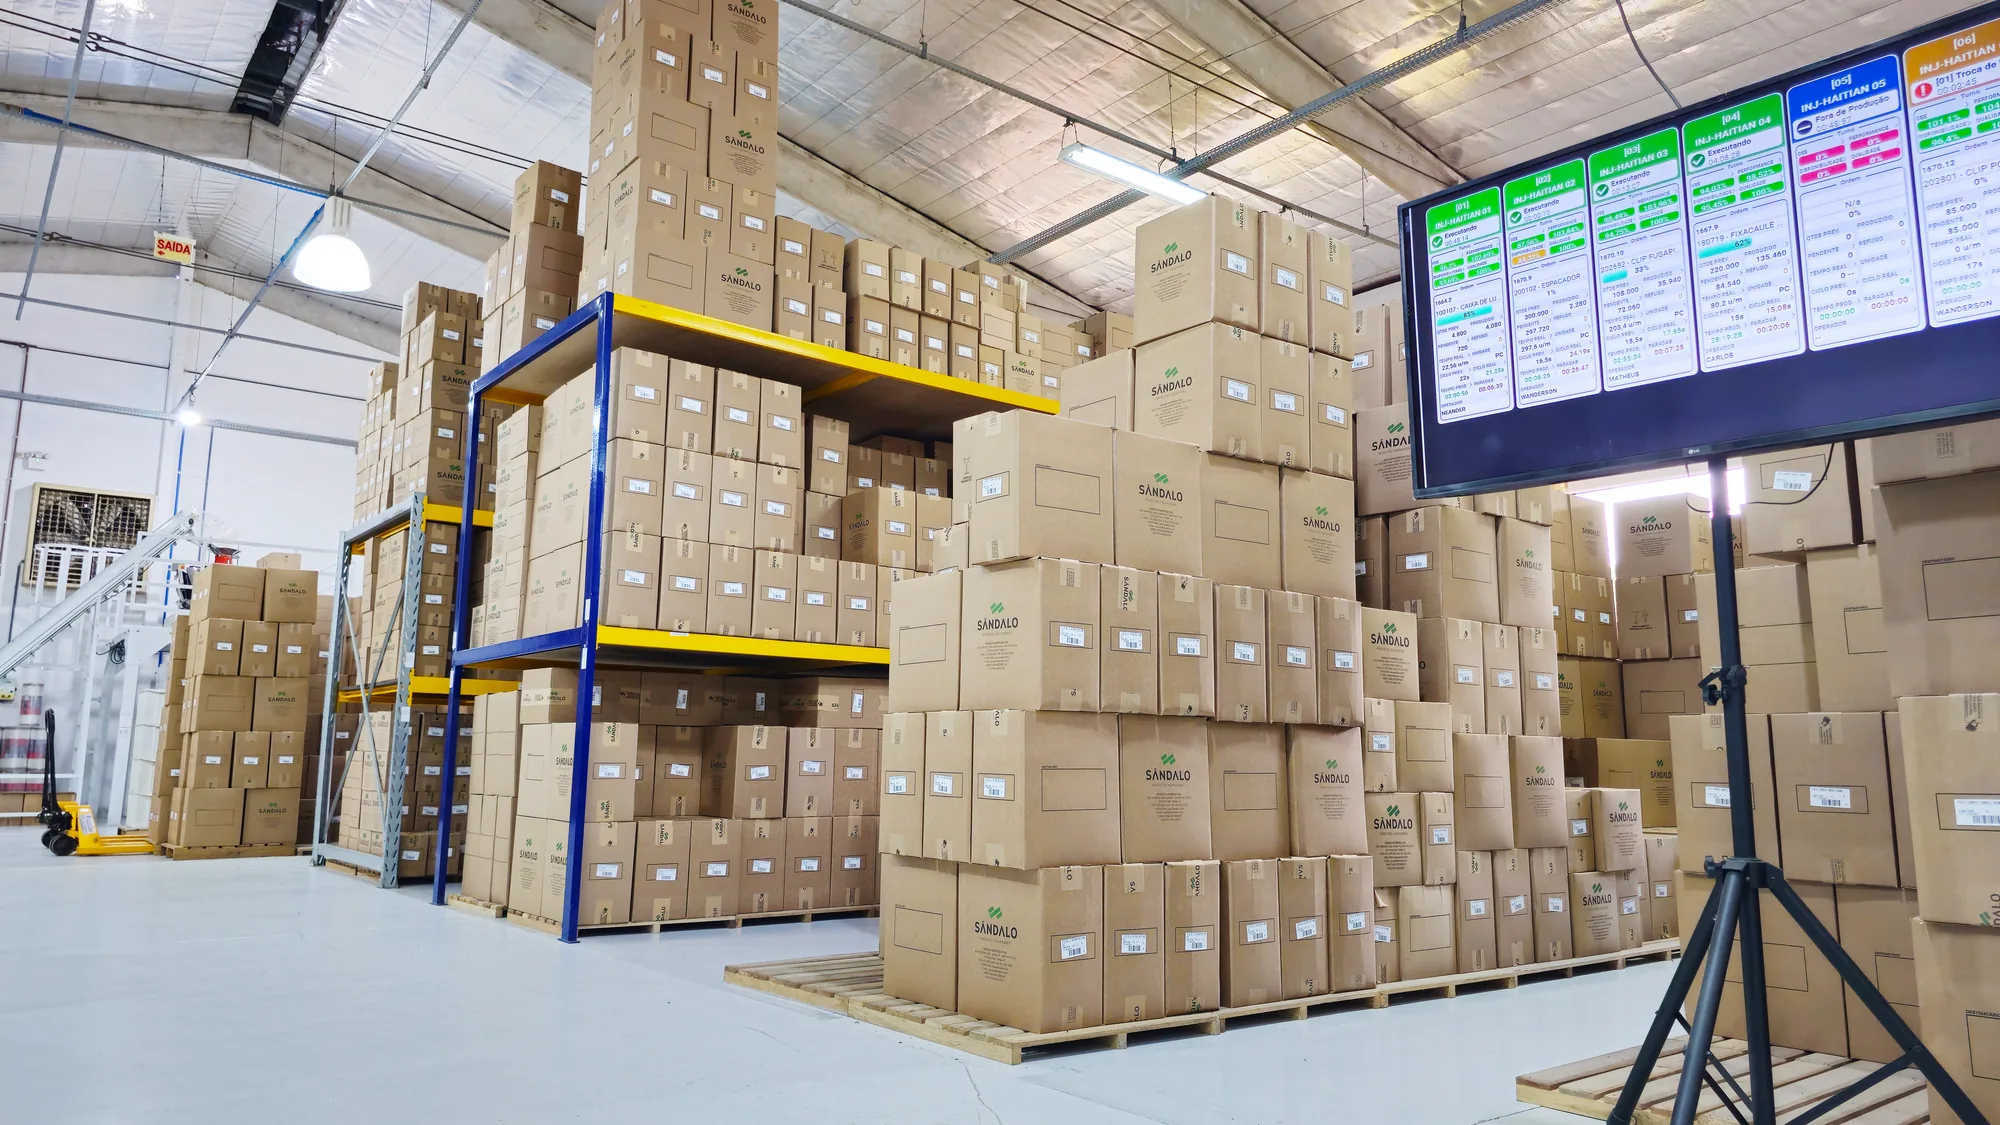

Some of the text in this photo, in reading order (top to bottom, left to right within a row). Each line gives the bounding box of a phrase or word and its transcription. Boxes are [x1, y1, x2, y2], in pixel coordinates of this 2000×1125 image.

[1954, 32, 1976, 50] [06]
[1920, 44, 1996, 75] INJ-HAITIAN
[1831, 73, 1852, 89] [05]
[1936, 62, 1997, 87] [01] Troca de
[1801, 78, 1886, 112] INJ-HAITIAN 05
[1815, 94, 1889, 123] Fora de Produção
[1721, 111, 1740, 125] [04]
[1695, 115, 1771, 146] INJ-HAITIAN 04
[1623, 143, 1640, 157] [03]
[1707, 137, 1751, 156] Executando
[1599, 148, 1668, 177] INJ-HAITIAN 03
[1966, 164, 1988, 176] CLIP
[1535, 174, 1550, 186] [02]
[1611, 169, 1650, 187] Executando
[1513, 178, 1575, 205] INJ-HAITIAN 02
[1751, 185, 1772, 197] 100%
[1455, 201, 1469, 212] [01]
[1523, 197, 1559, 214] Executando
[1435, 205, 1490, 230] INJ-HAITIAN 01
[1898, 219, 1904, 227] 0
[1444, 223, 1477, 239] Executando
[1696, 223, 1718, 235] 1667.9
[1697, 221, 1774, 247] 180719 FIXACAULE
[158, 239, 190, 255] SAÍDA
[1734, 237, 1750, 247] 62%
[1151, 250, 1192, 272] SÂNDALO
[1630, 255, 1647, 265] CLIP
[1756, 249, 1786, 262] 135.460
[1634, 264, 1649, 274] 33%
[1710, 261, 1739, 274] 220.000
[1967, 262, 1984, 270] 17s
[1657, 275, 1681, 287] 35.940
[1715, 278, 1741, 290] 84.540
[1778, 284, 1789, 293] PC
[1846, 288, 1856, 296] 0s
[1460, 299, 1479, 310] CAIXA
[1479, 297, 1487, 305] DE
[1710, 295, 1742, 309] 80,2 u/m
[1936, 300, 1992, 316] WANDERSON
[1674, 309, 1684, 317] PC
[1730, 312, 1743, 322] 15s
[1627, 319, 1641, 328] u/m
[1580, 331, 1589, 339] PC
[1538, 339, 1550, 348] u/m
[1706, 351, 1733, 363] CARLOS
[1608, 370, 1639, 382] MATHEUS
[1152, 376, 1192, 396] SÂNDALO
[1521, 386, 1557, 401] WANDERSON
[1441, 406, 1465, 416] NEANDER
[1138, 484, 1182, 502] SÂNDALO
[1304, 516, 1340, 532] SÂNDALO
[1630, 522, 1672, 534] SÂNDALO
[978, 617, 1018, 631] SÂNDALO
[1370, 632, 1410, 648] SÂNDALO
[1146, 768, 1190, 781] SÂNDALO
[1314, 772, 1350, 783] SÂNDALO
[1374, 816, 1412, 830] SÂNDALO
[1610, 812, 1638, 822] SÂNDALO
[1582, 894, 1612, 906] SÂNDALO
[974, 920, 1017, 939] SÂNDALO
